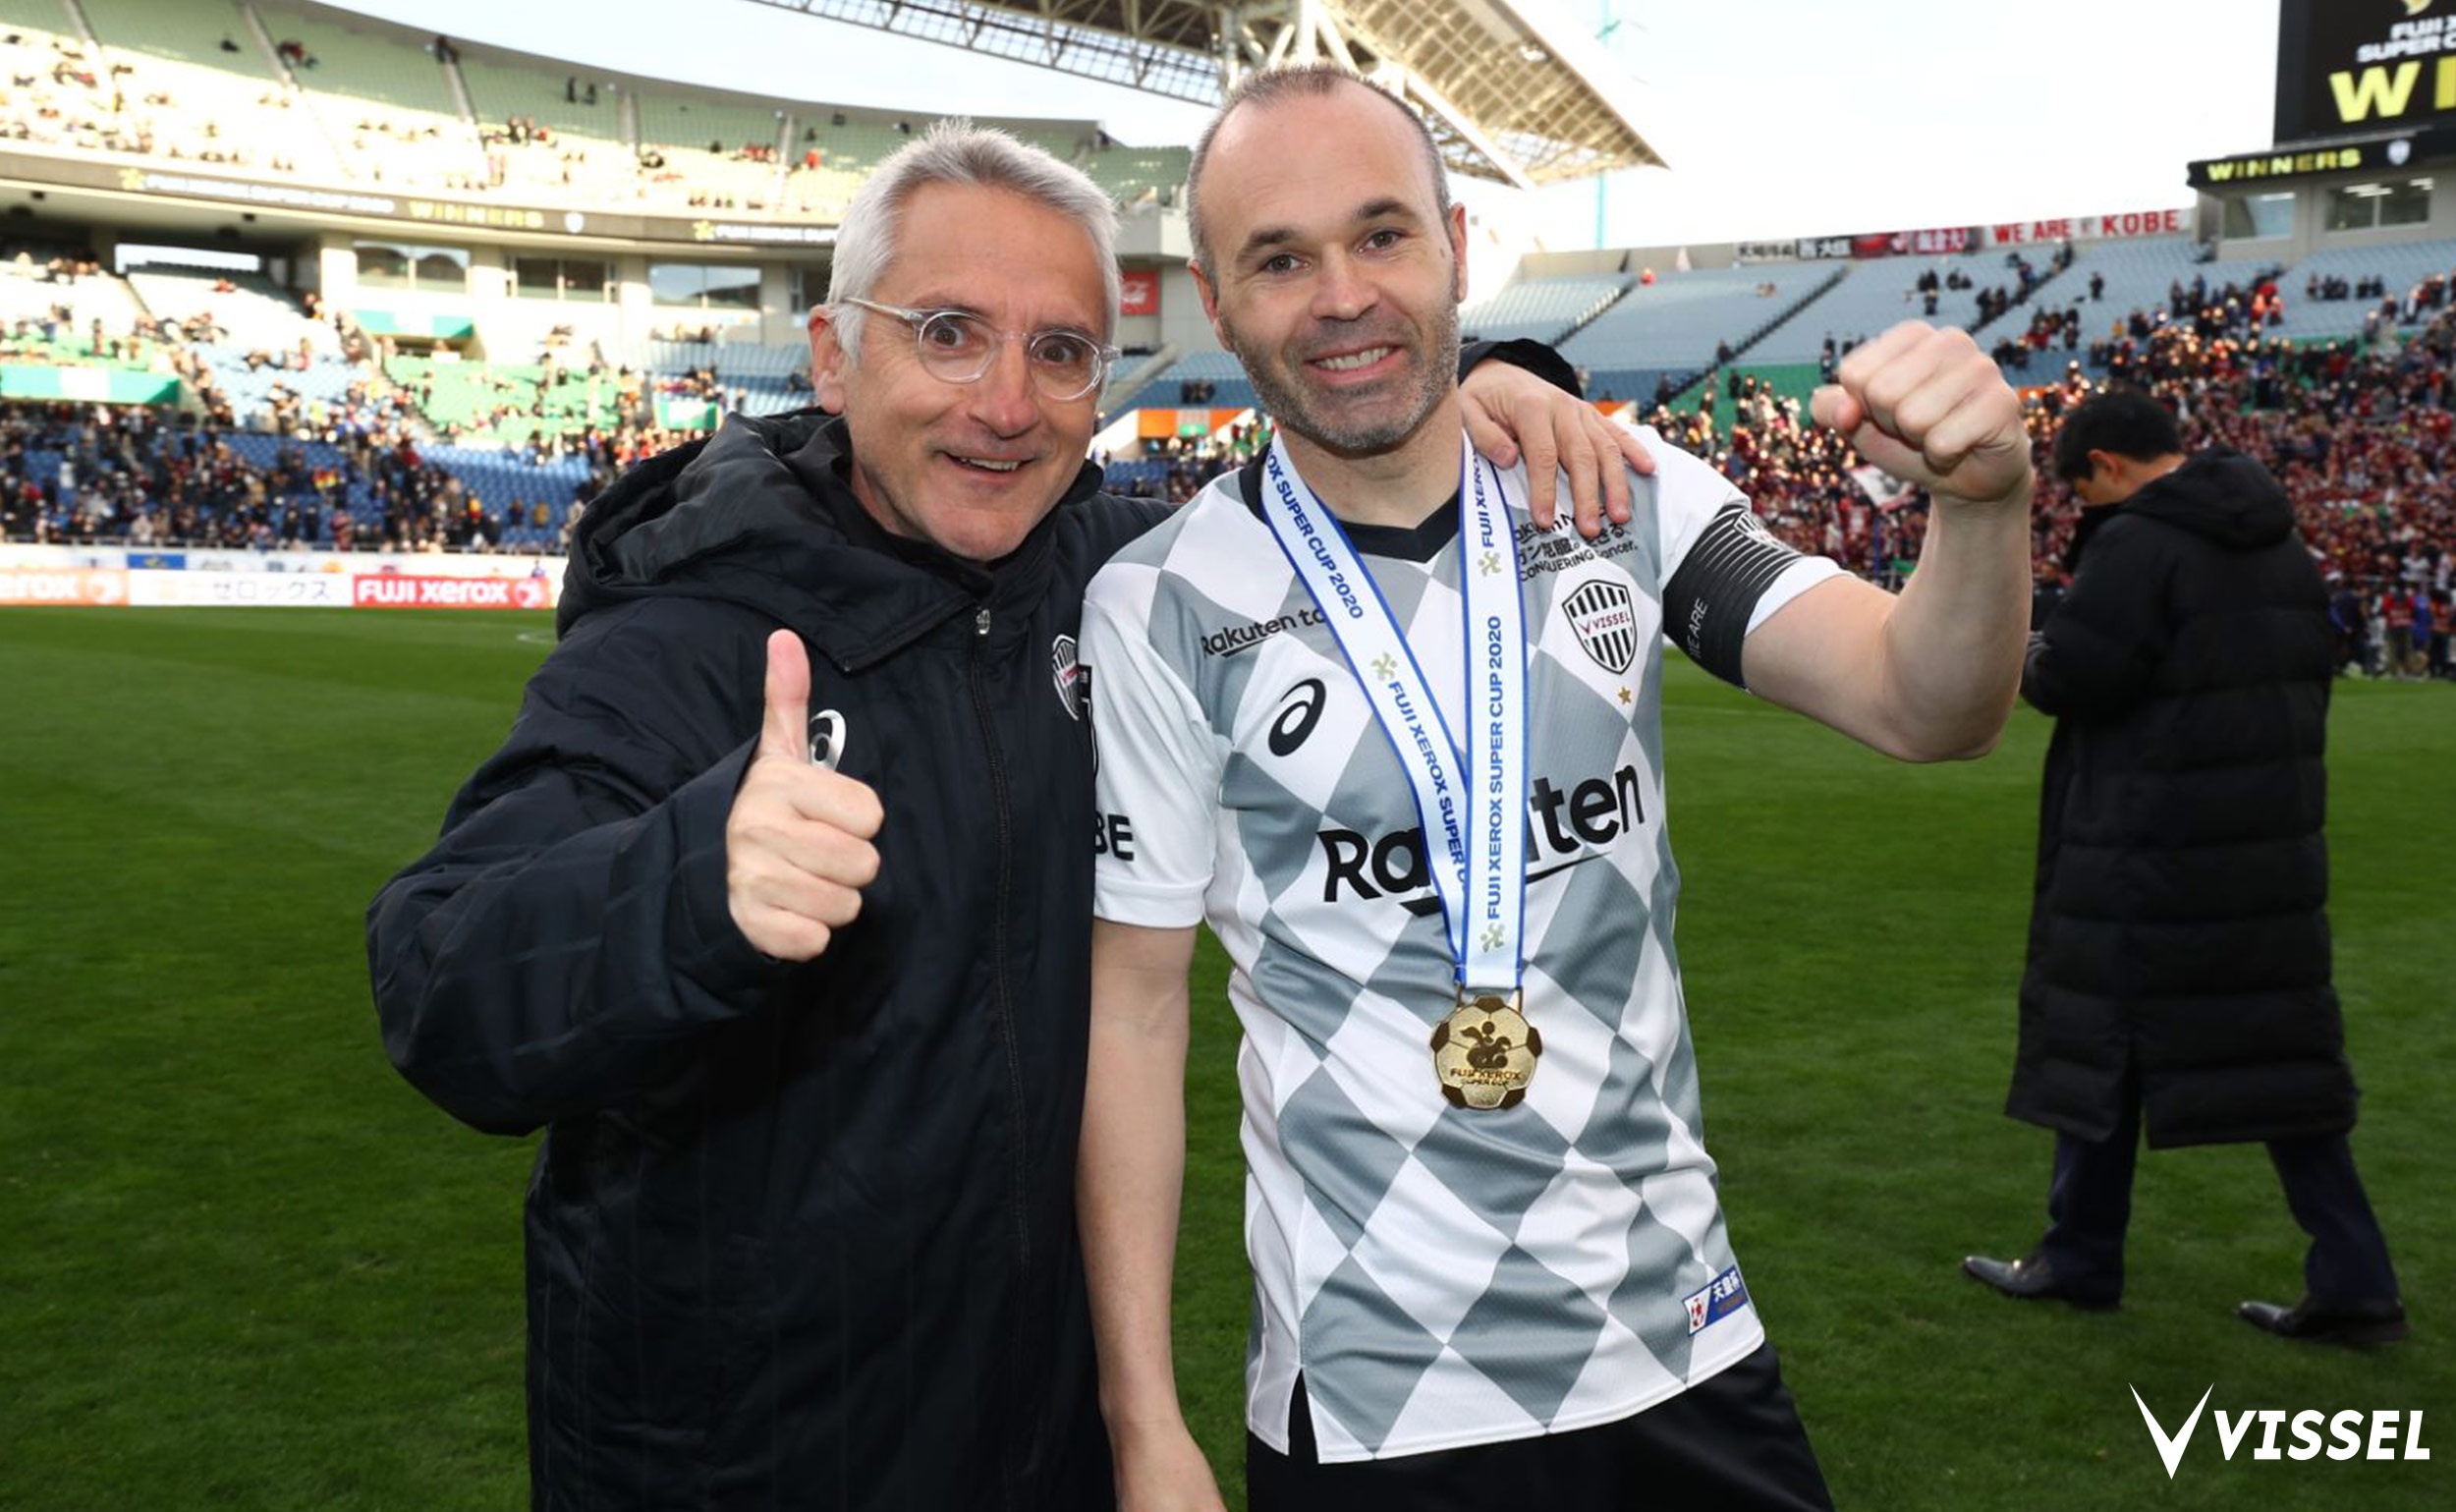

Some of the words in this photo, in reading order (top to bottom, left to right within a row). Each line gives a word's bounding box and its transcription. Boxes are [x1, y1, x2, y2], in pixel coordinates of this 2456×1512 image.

[2356, 34, 2440, 63] SUPER
[2207, 148, 2362, 181] WINNERS
[408, 199, 545, 229] WINNERS
[1992, 223, 2024, 244] WE
[2033, 218, 2073, 241] ARE
[2101, 209, 2180, 236] KOBE
[1277, 479, 1314, 537] SUPER
[1308, 535, 1337, 572] CUP
[1328, 571, 1364, 619] 2020
[1479, 511, 1494, 548] FUJI
[357, 580, 418, 603] FUJI
[1591, 610, 1631, 629] VISSEL
[1688, 596, 1708, 637] ARE
[1487, 615, 1502, 670] 2020
[1489, 673, 1503, 718] CUP
[1387, 680, 1418, 723] FUJI
[1409, 723, 1449, 797] XEROX
[1438, 796, 1466, 866] SUPER
[1489, 721, 1504, 795] SUPER
[1488, 798, 1503, 871] XEROX
[1486, 874, 1502, 921] FUJI
[1479, 1069, 1521, 1080] XEROX
